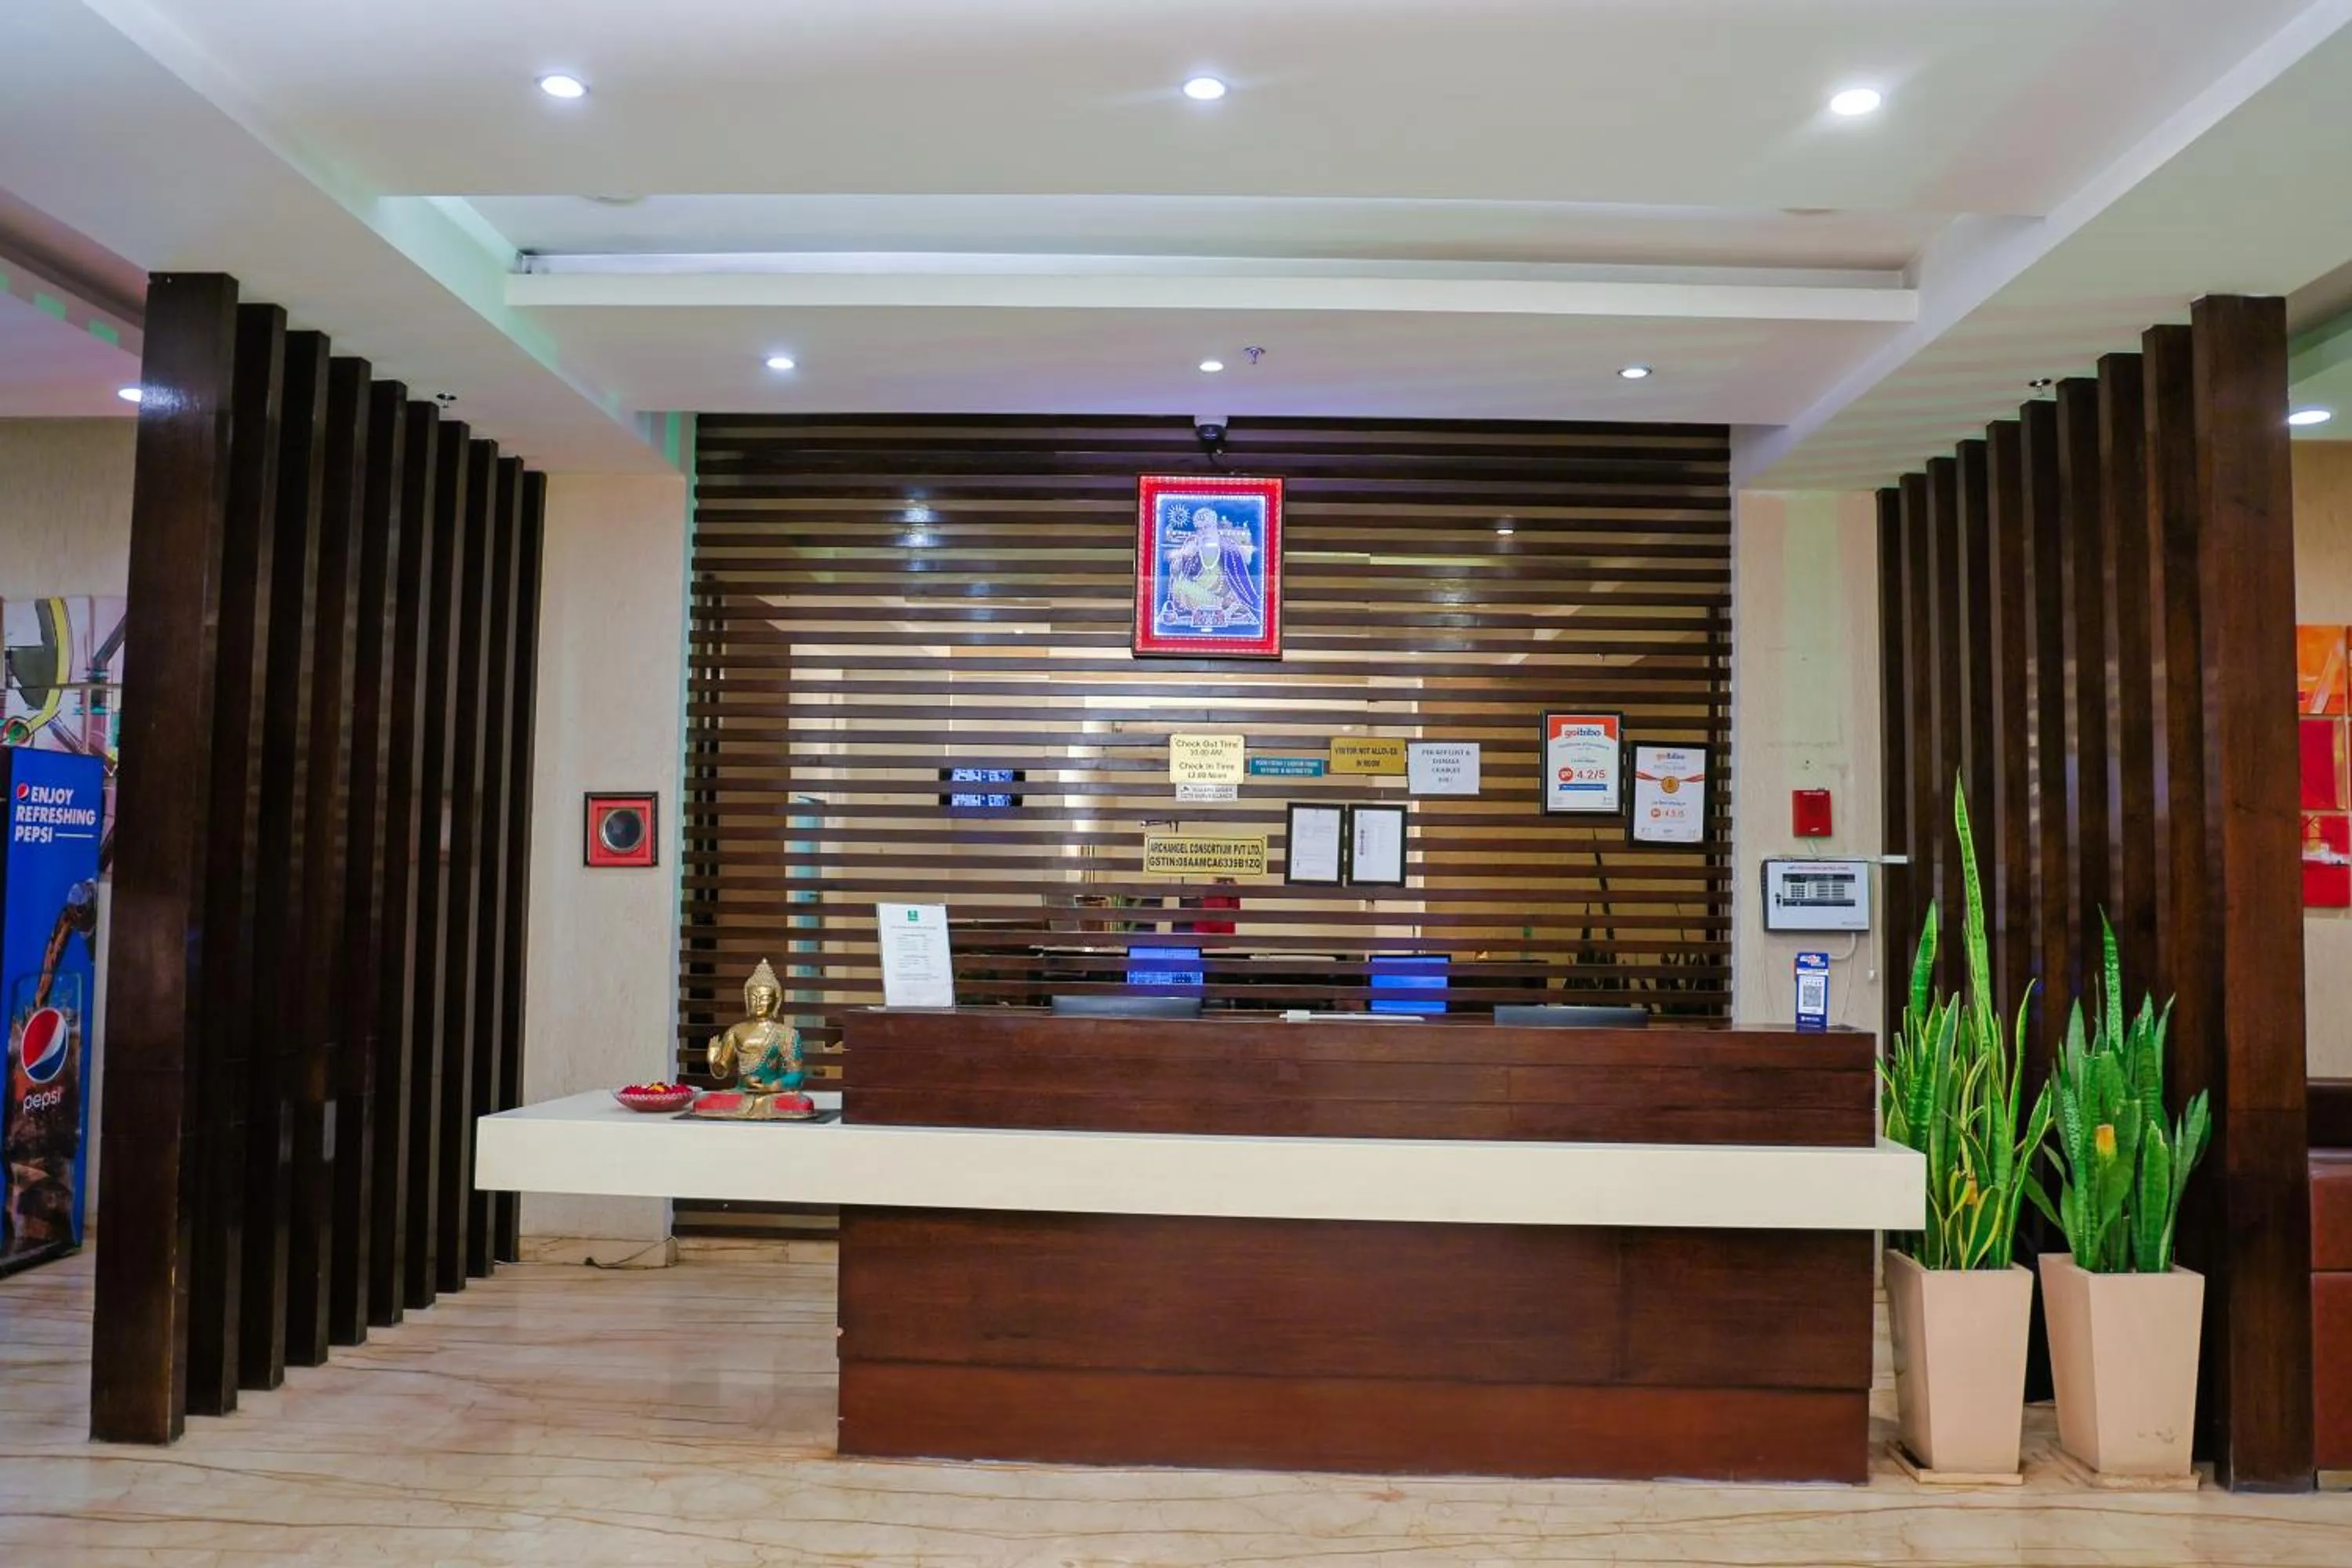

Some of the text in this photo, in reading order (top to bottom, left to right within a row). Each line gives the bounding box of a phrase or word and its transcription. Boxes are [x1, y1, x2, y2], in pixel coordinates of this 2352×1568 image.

[1564, 726, 1602, 739] goibibo
[1175, 739, 1238, 748] Check Out Time
[1178, 761, 1203, 770] Check
[31, 786, 74, 805] ENJOY
[15, 804, 96, 826] REFRESHING
[14, 825, 53, 844] PEPSI
[1150, 843, 1188, 854] ARCHANGEL
[1189, 843, 1232, 855] CONSORTIUM
[1233, 844, 1247, 855] PVT
[23, 1088, 62, 1116] pepsi
